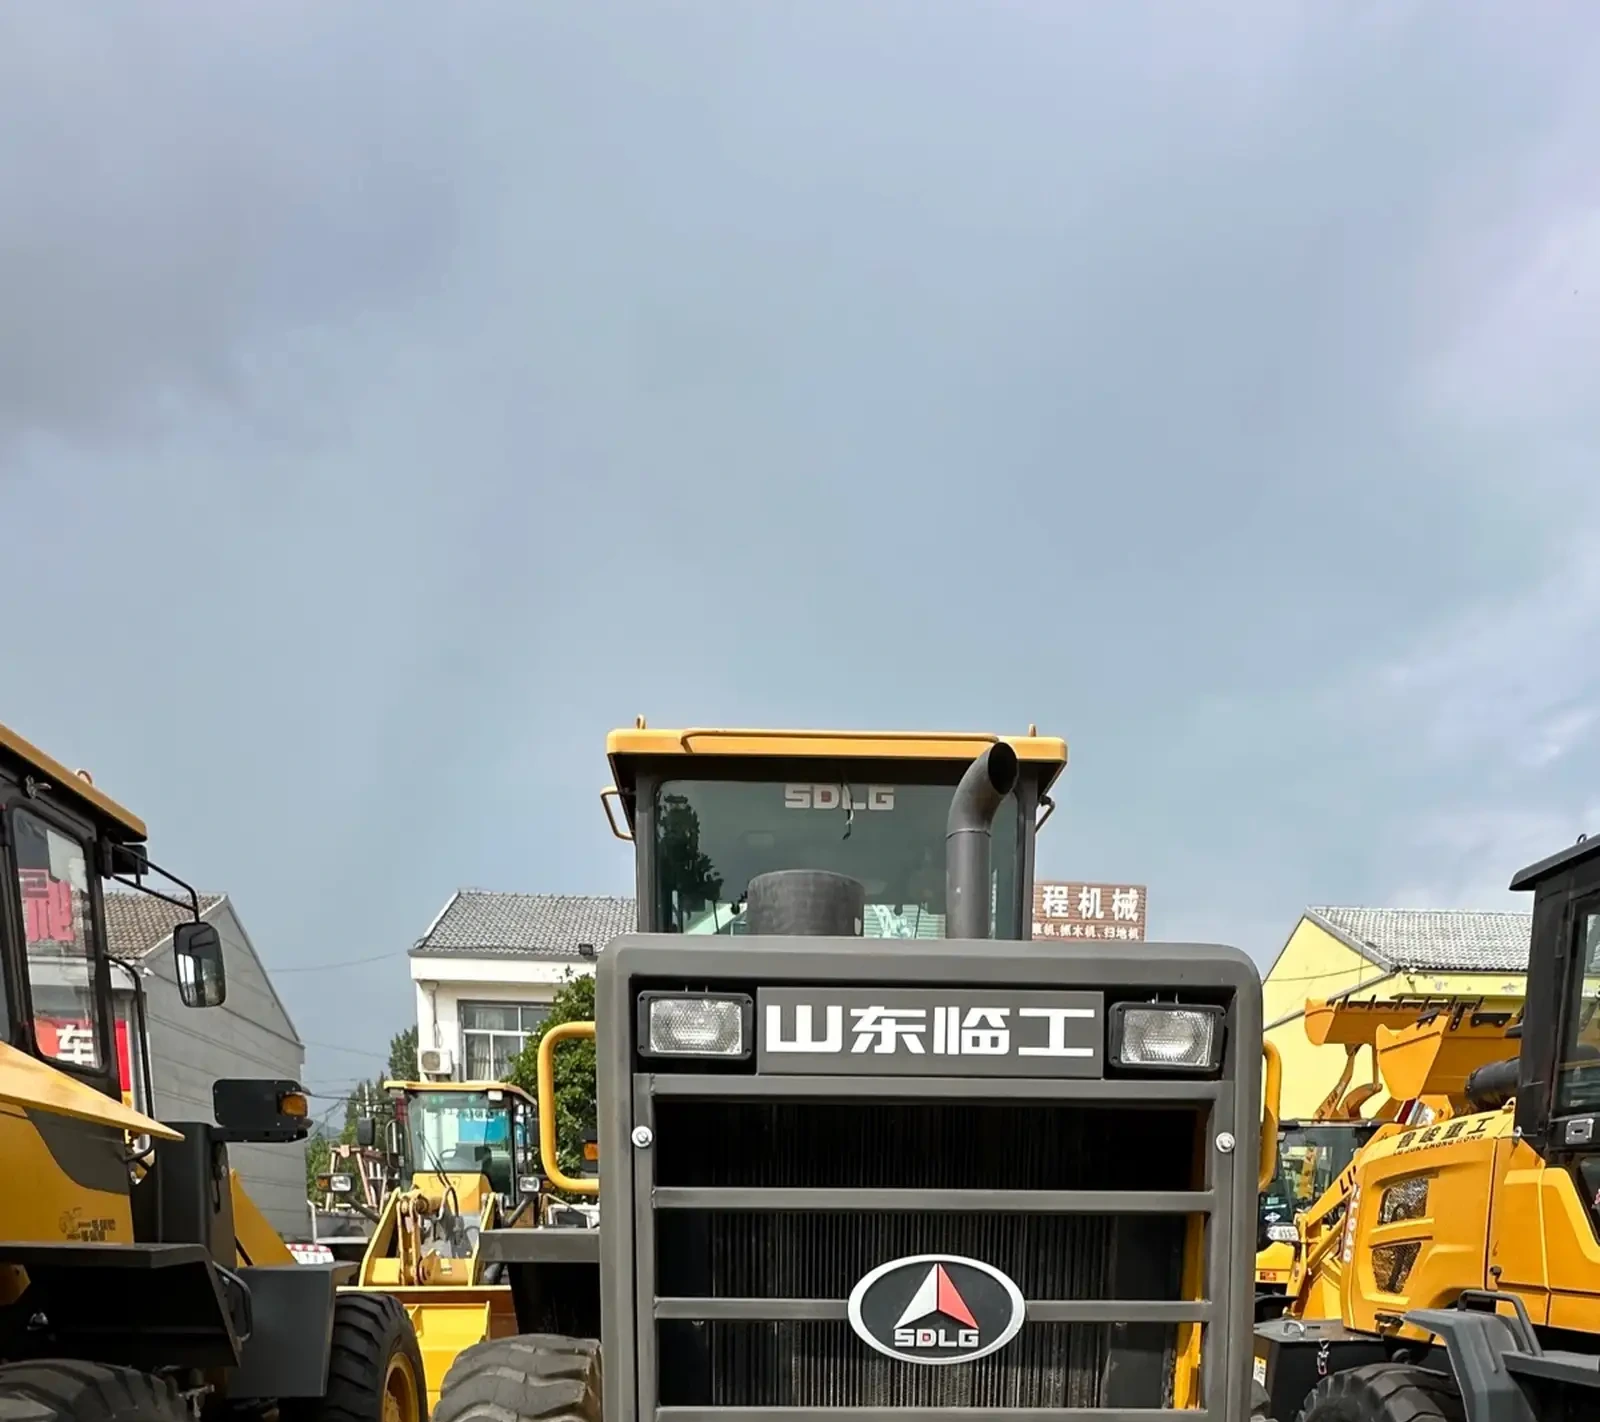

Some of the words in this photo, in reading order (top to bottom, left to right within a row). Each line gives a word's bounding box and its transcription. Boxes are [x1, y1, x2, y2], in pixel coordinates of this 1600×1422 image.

[784, 784, 895, 810] SDLG
[1032, 885, 1139, 922] 程机械
[766, 1005, 1095, 1057] 山东临工
[894, 1328, 979, 1348] SDLG
